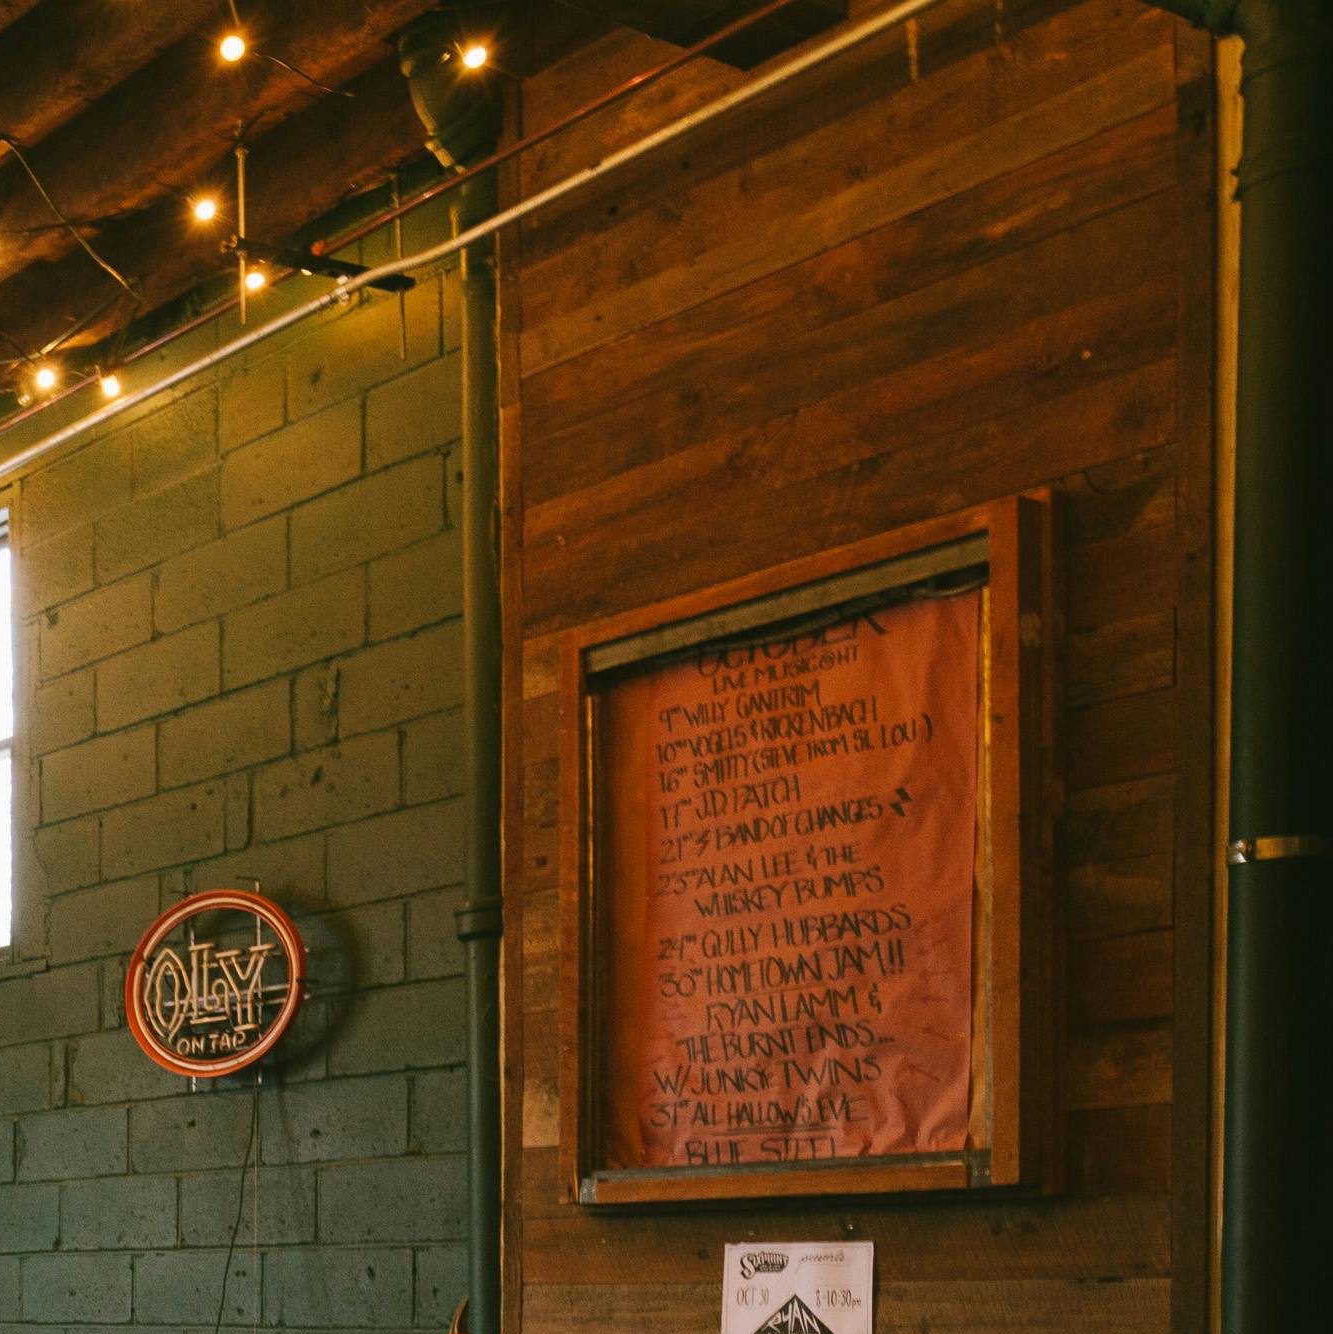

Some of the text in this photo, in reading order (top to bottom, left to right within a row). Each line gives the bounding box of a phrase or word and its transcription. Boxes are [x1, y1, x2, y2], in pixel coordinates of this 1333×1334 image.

[682, 700, 730, 729] WILLY
[696, 857, 754, 889] ALAN
[760, 850, 801, 880] LEE
[822, 841, 863, 866] THE
[693, 864, 885, 919] WHISKEY BUMPS
[772, 902, 913, 949] HUBBARDS
[707, 950, 823, 996] HOMETOWN
[827, 937, 905, 981] JAM!!
[143, 942, 278, 1045] OLY
[706, 995, 776, 1032] RYAN
[779, 984, 859, 1023] LAMM
[176, 1031, 246, 1056] ON TAP
[675, 1033, 719, 1065] THE
[721, 1028, 797, 1062] BURNT
[782, 1054, 882, 1089] TWINS
[692, 1101, 719, 1127] ALL
[736, 1287, 756, 1307] OCT
[760, 1299, 822, 1334] RYAN
